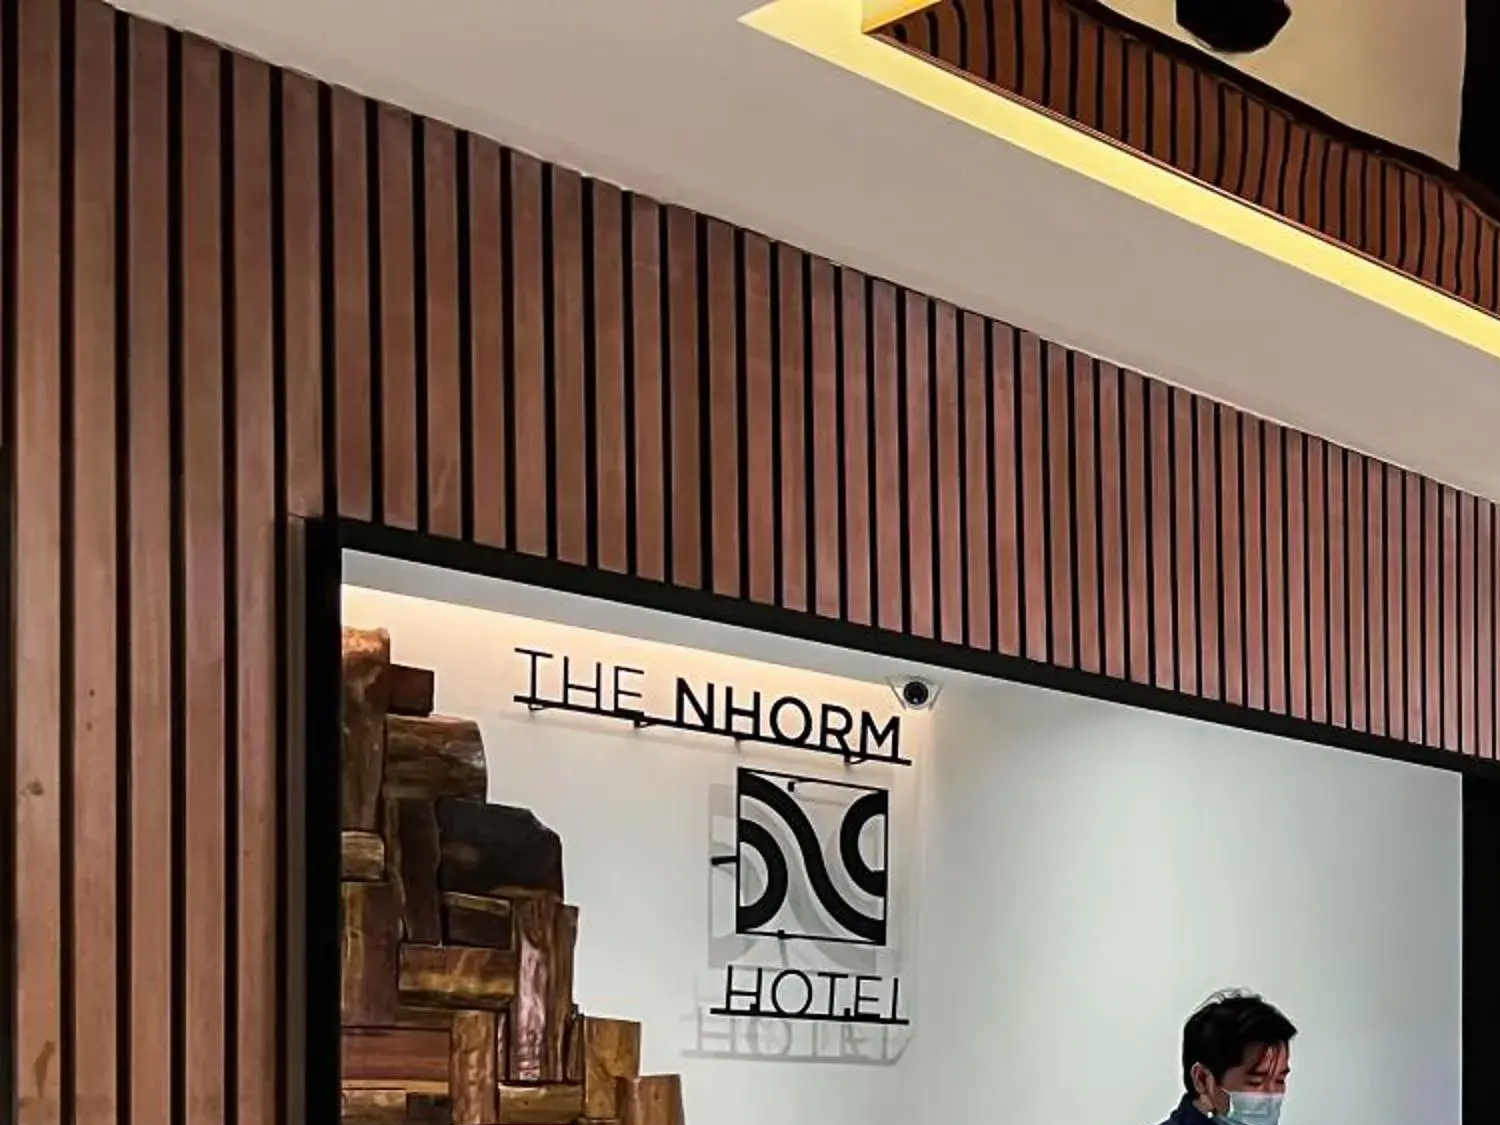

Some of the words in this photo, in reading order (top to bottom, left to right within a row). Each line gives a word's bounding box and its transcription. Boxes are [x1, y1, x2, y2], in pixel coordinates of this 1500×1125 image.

[514, 647, 645, 715] THE
[675, 677, 904, 761] NHORM
[727, 965, 909, 1024] HOTEL
